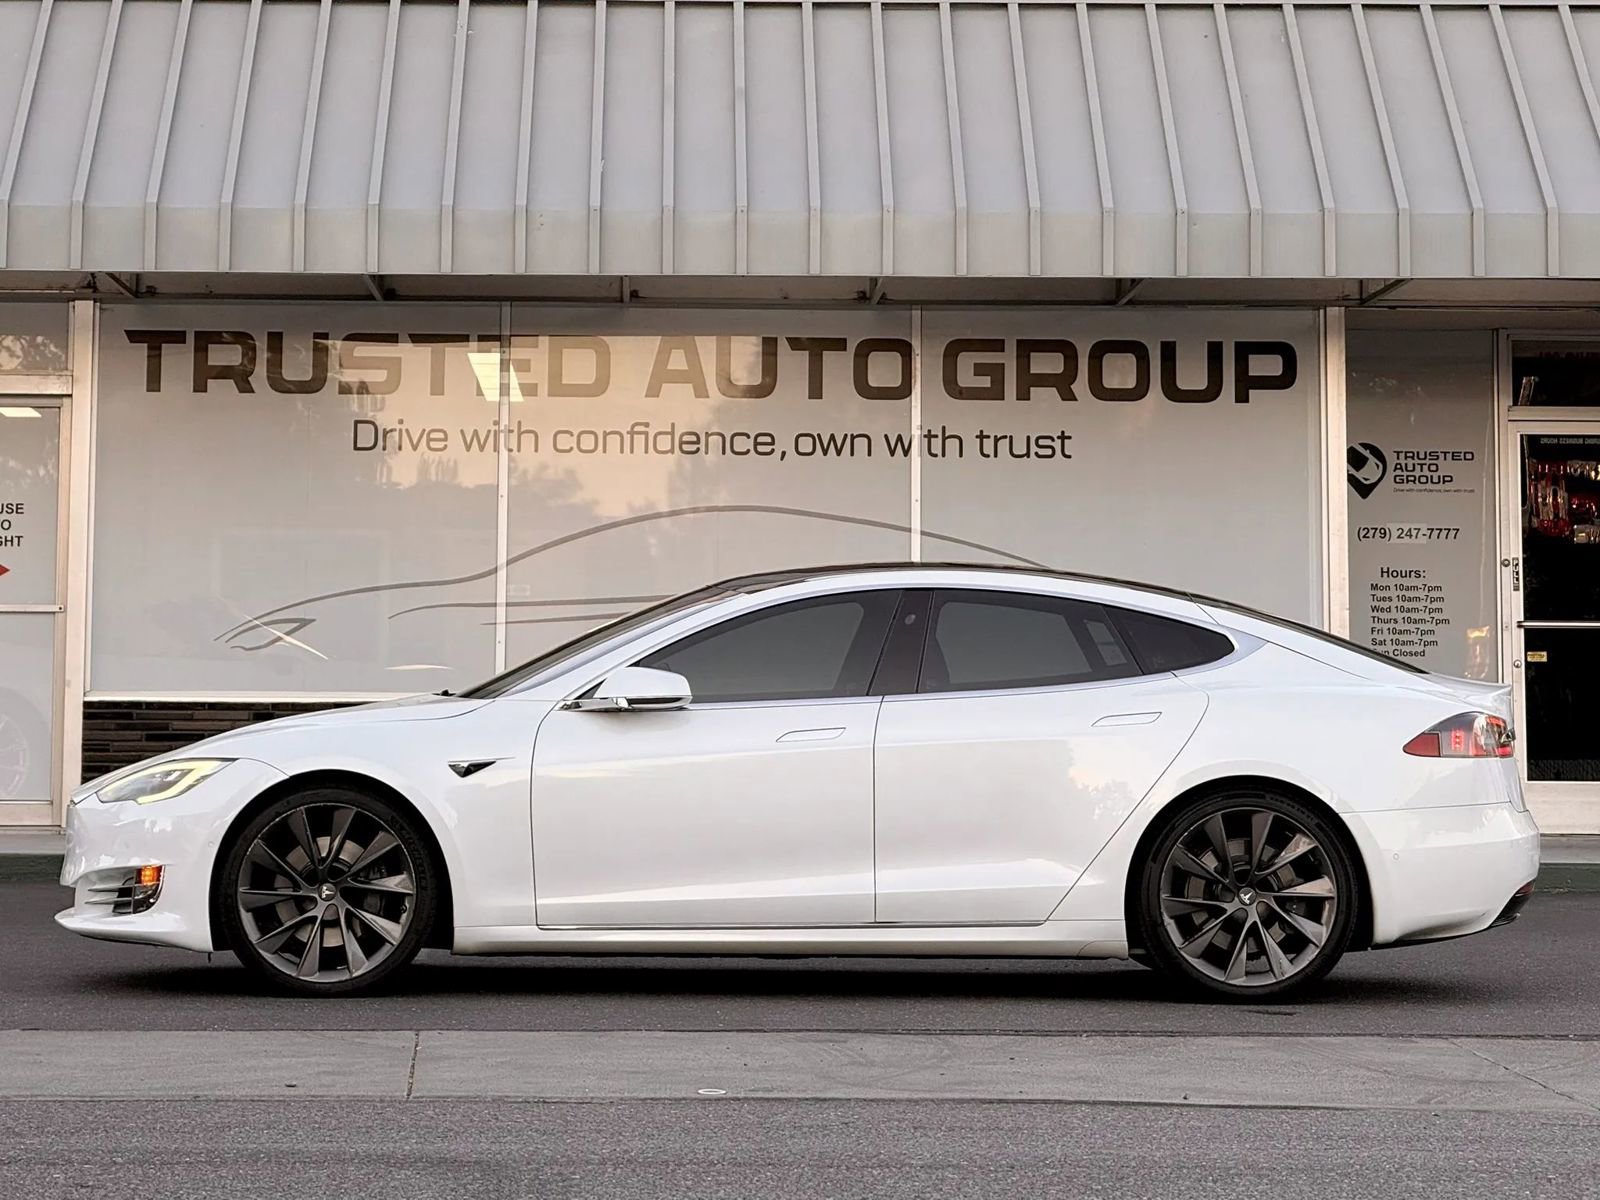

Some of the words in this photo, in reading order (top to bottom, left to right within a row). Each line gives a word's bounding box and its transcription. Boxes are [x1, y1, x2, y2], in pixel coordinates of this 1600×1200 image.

[124, 329, 610, 398] TRUSTED
[645, 336, 912, 400] AUTO
[942, 338, 1297, 403] GROUP
[353, 419, 449, 452] Drive
[460, 420, 539, 453] with
[552, 422, 787, 461] confidence,
[794, 431, 872, 457] own
[883, 425, 964, 458] wth
[976, 429, 1072, 459] trust
[1393, 450, 1475, 461] TRUSTED
[1393, 462, 1439, 473] AUTO
[1393, 474, 1454, 485] GROUP
[1357, 526, 1392, 541] (279)
[1396, 527, 1460, 540] 247-7777
[1380, 567, 1426, 579] Hours:
[1370, 583, 1391, 592] Mon
[1394, 583, 1442, 593] 10am-7pm
[1370, 594, 1393, 602] Tues
[1396, 594, 1445, 604] 10am-7pm
[1370, 605, 1392, 613] Wed
[1394, 605, 1443, 615] 10am-7pm
[1371, 616, 1398, 624] Thurs
[1401, 616, 1450, 626] 10am-7pm
[1371, 627, 1384, 635] Fri
[1386, 627, 1435, 637] 10am-7pm
[1371, 637, 1387, 646] Sat
[1389, 638, 1438, 648] 10am-7pm
[1392, 648, 1426, 657] Closed
